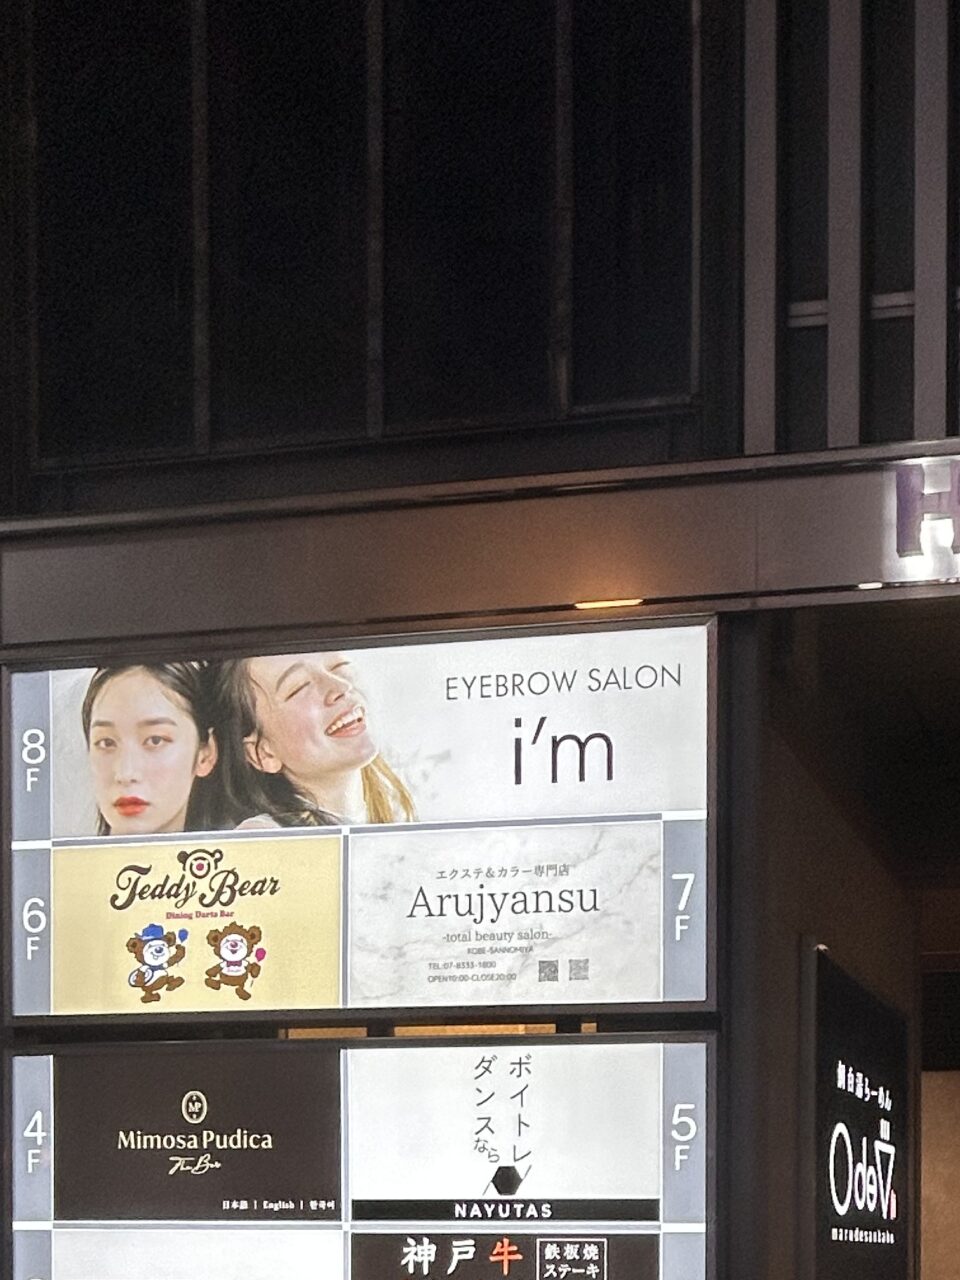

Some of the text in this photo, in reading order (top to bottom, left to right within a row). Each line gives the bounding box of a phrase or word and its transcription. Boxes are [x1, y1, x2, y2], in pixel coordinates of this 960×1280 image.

[446, 663, 681, 700] EYEBROW SALON
[110, 864, 281, 910] Teddy Bear
[406, 884, 600, 924] Arujyansu
[166, 912, 193, 920] Dining
[220, 910, 235, 918] Bar
[475, 929, 514, 944] beauty
[510, 1053, 532, 1162] ボイトレ
[118, 1128, 273, 1149] Mimosa Pudica
[263, 1200, 295, 1211] English
[454, 1203, 552, 1218] NAYUTAS
[401, 1237, 523, 1276] 神戸牛
[543, 1264, 600, 1279] ステーキ
